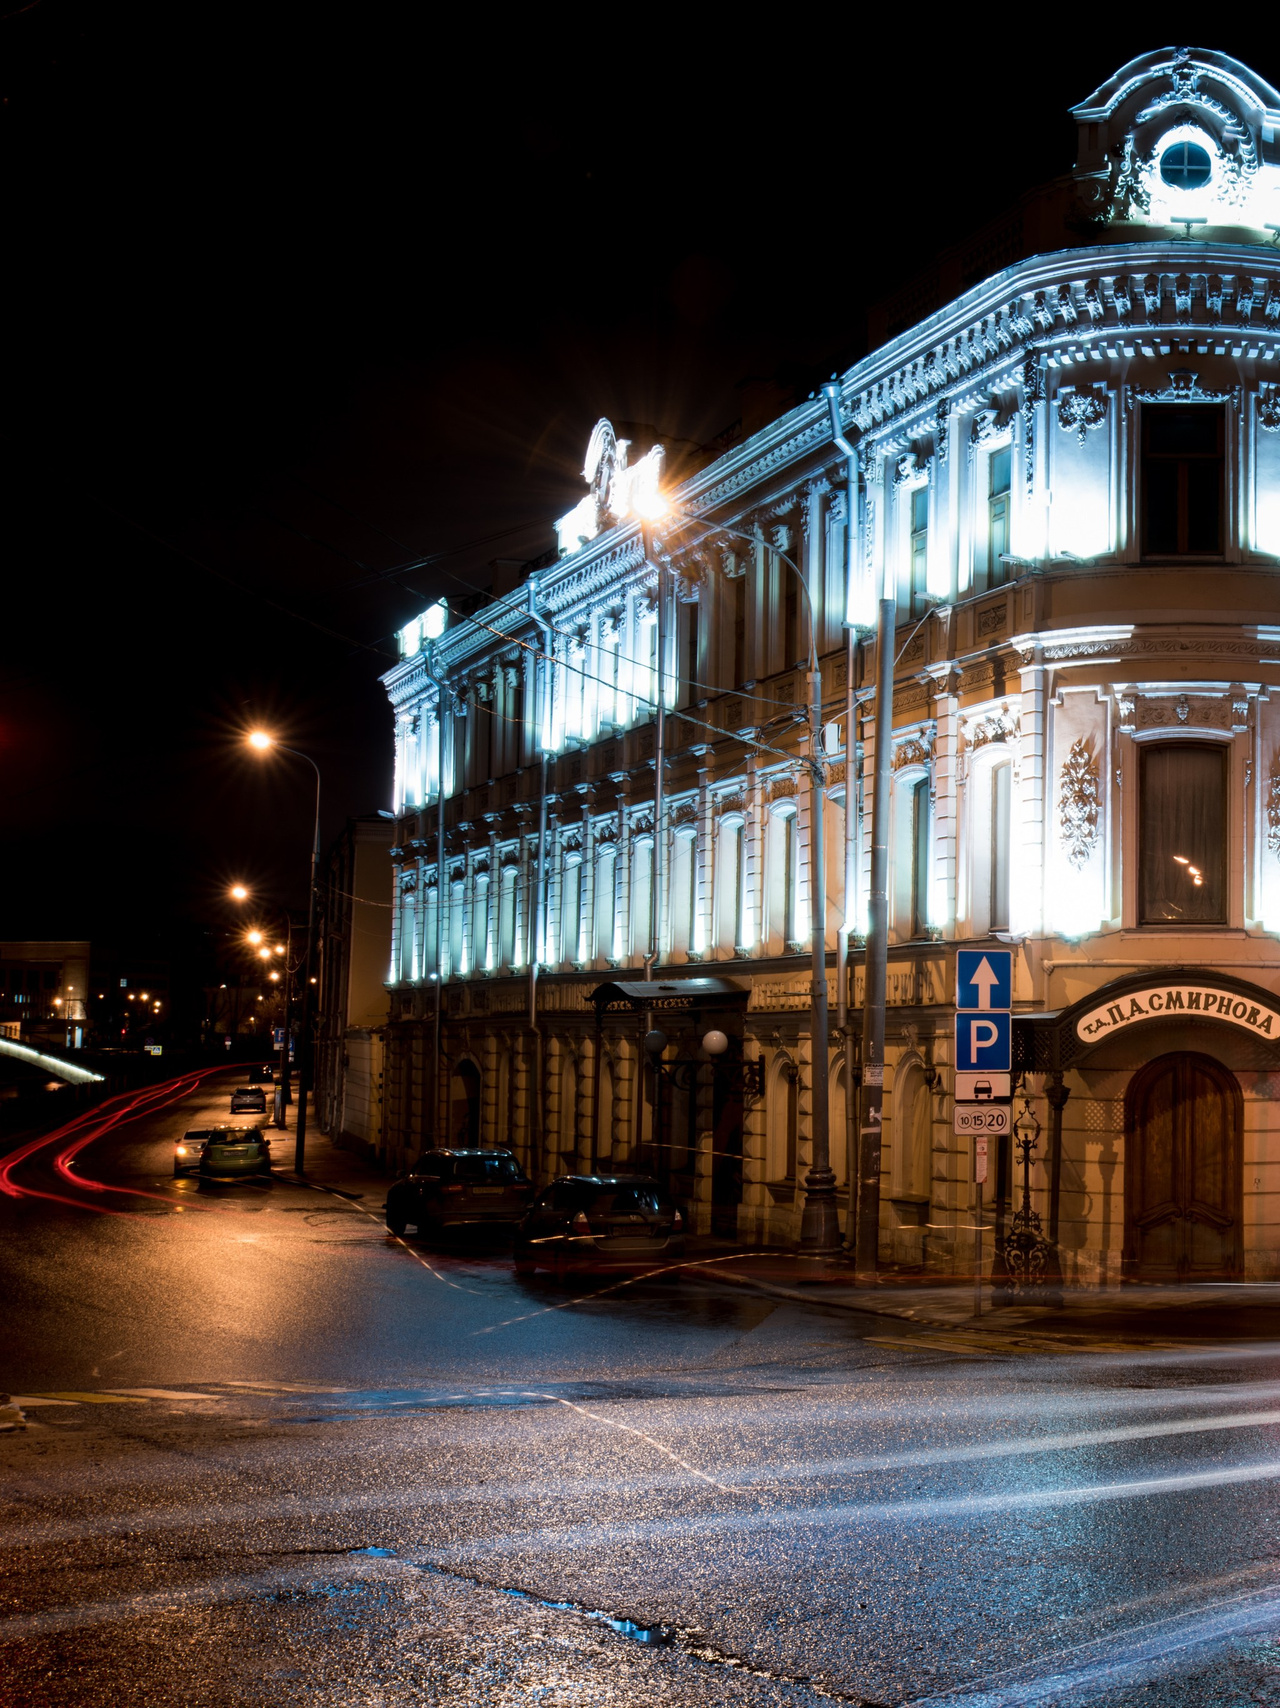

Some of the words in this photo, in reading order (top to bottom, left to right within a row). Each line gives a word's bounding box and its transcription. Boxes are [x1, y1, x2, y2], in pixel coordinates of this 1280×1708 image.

[1148, 990, 1274, 1034] СМИРНОВА
[970, 1019, 999, 1064] P
[960, 1116, 970, 1126] 10
[972, 1115, 984, 1126] 15
[987, 1113, 1005, 1127] 20
